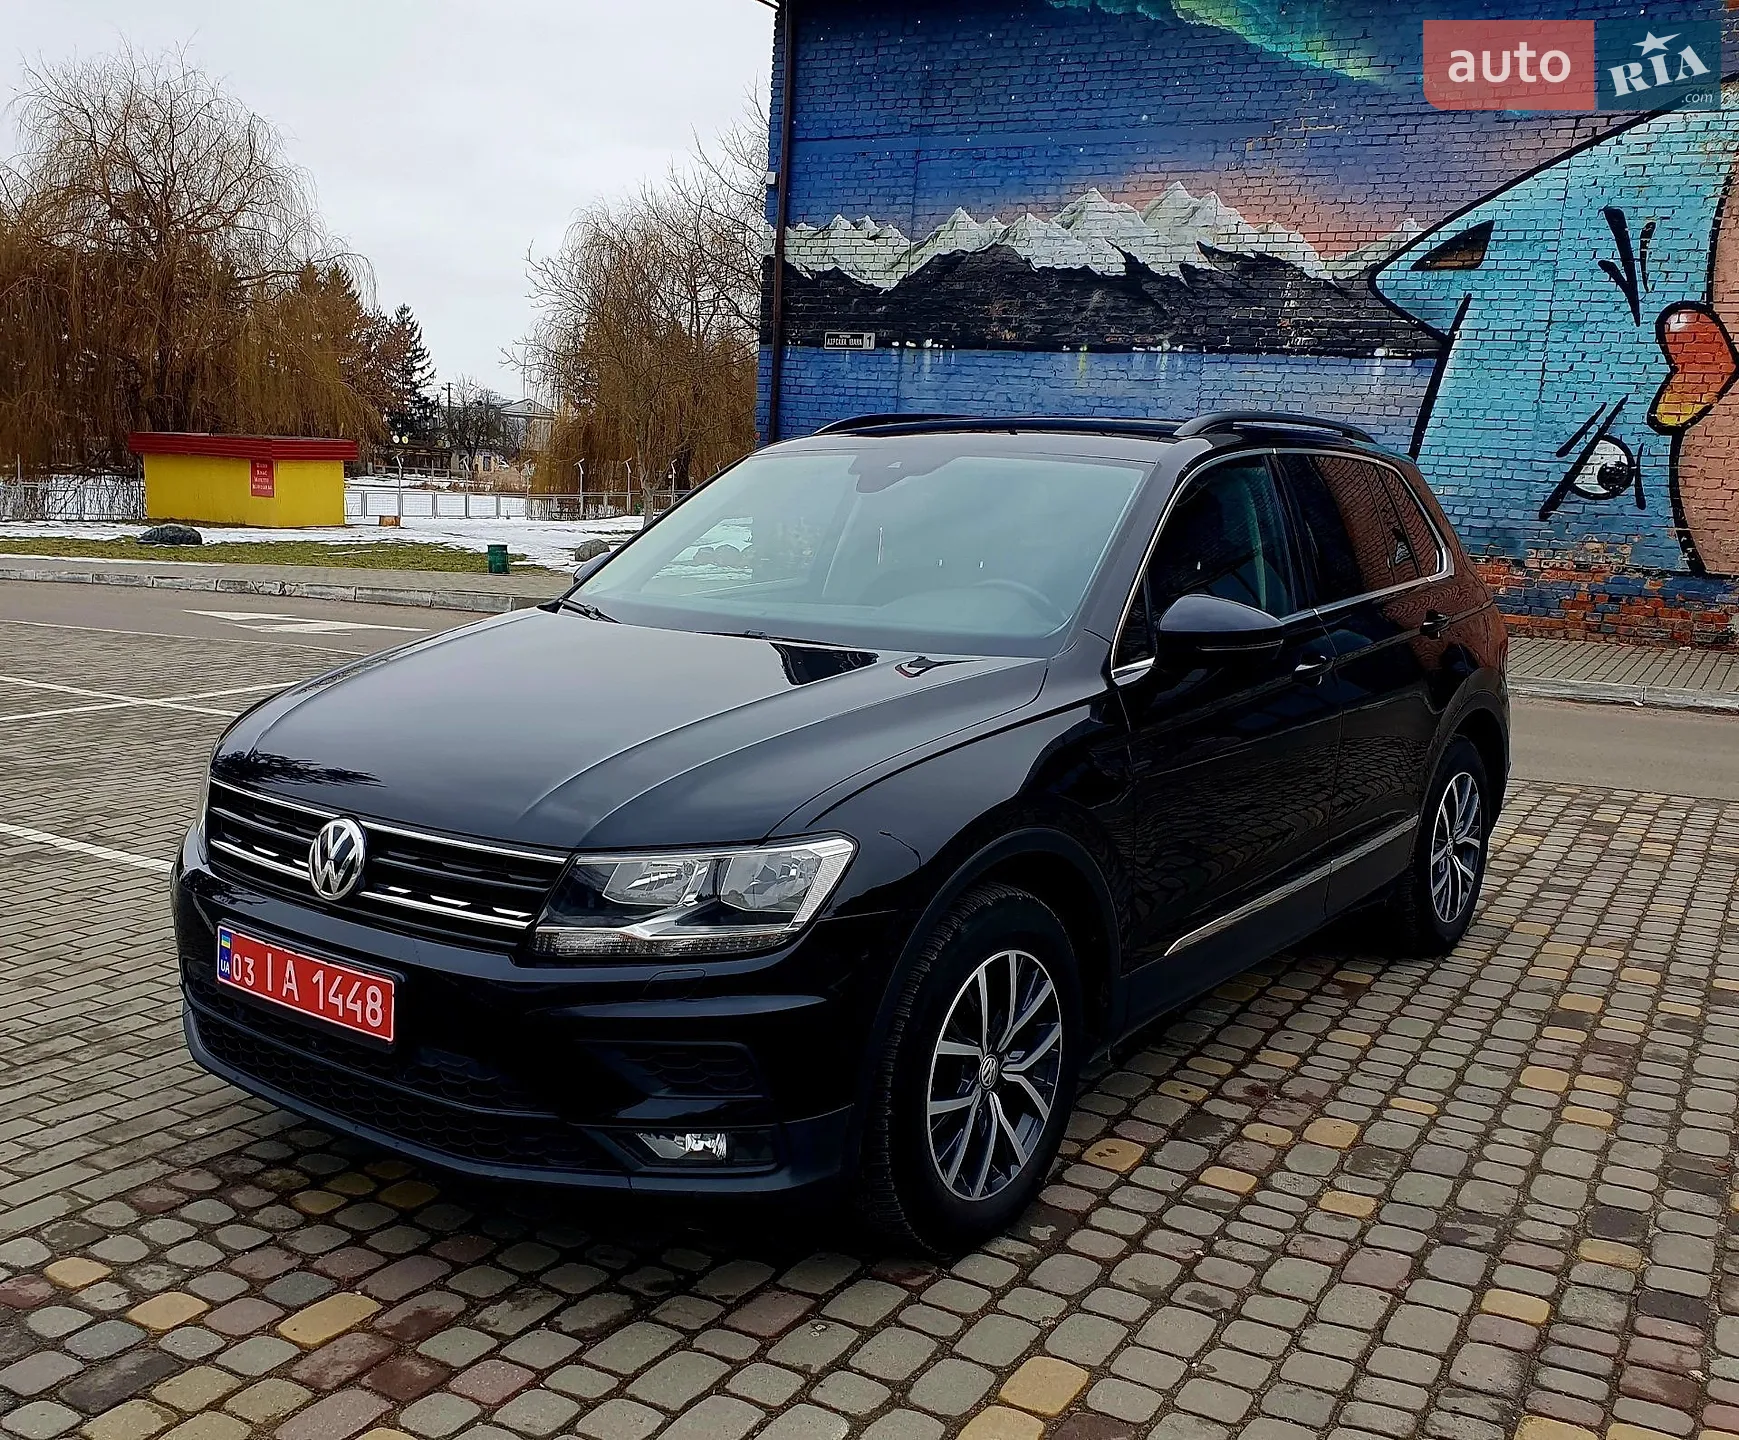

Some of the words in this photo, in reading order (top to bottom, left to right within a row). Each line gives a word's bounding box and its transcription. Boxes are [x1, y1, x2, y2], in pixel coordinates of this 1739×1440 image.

[220, 959, 230, 975] UA
[232, 953, 255, 987] 03
[312, 969, 383, 1028] 1448
